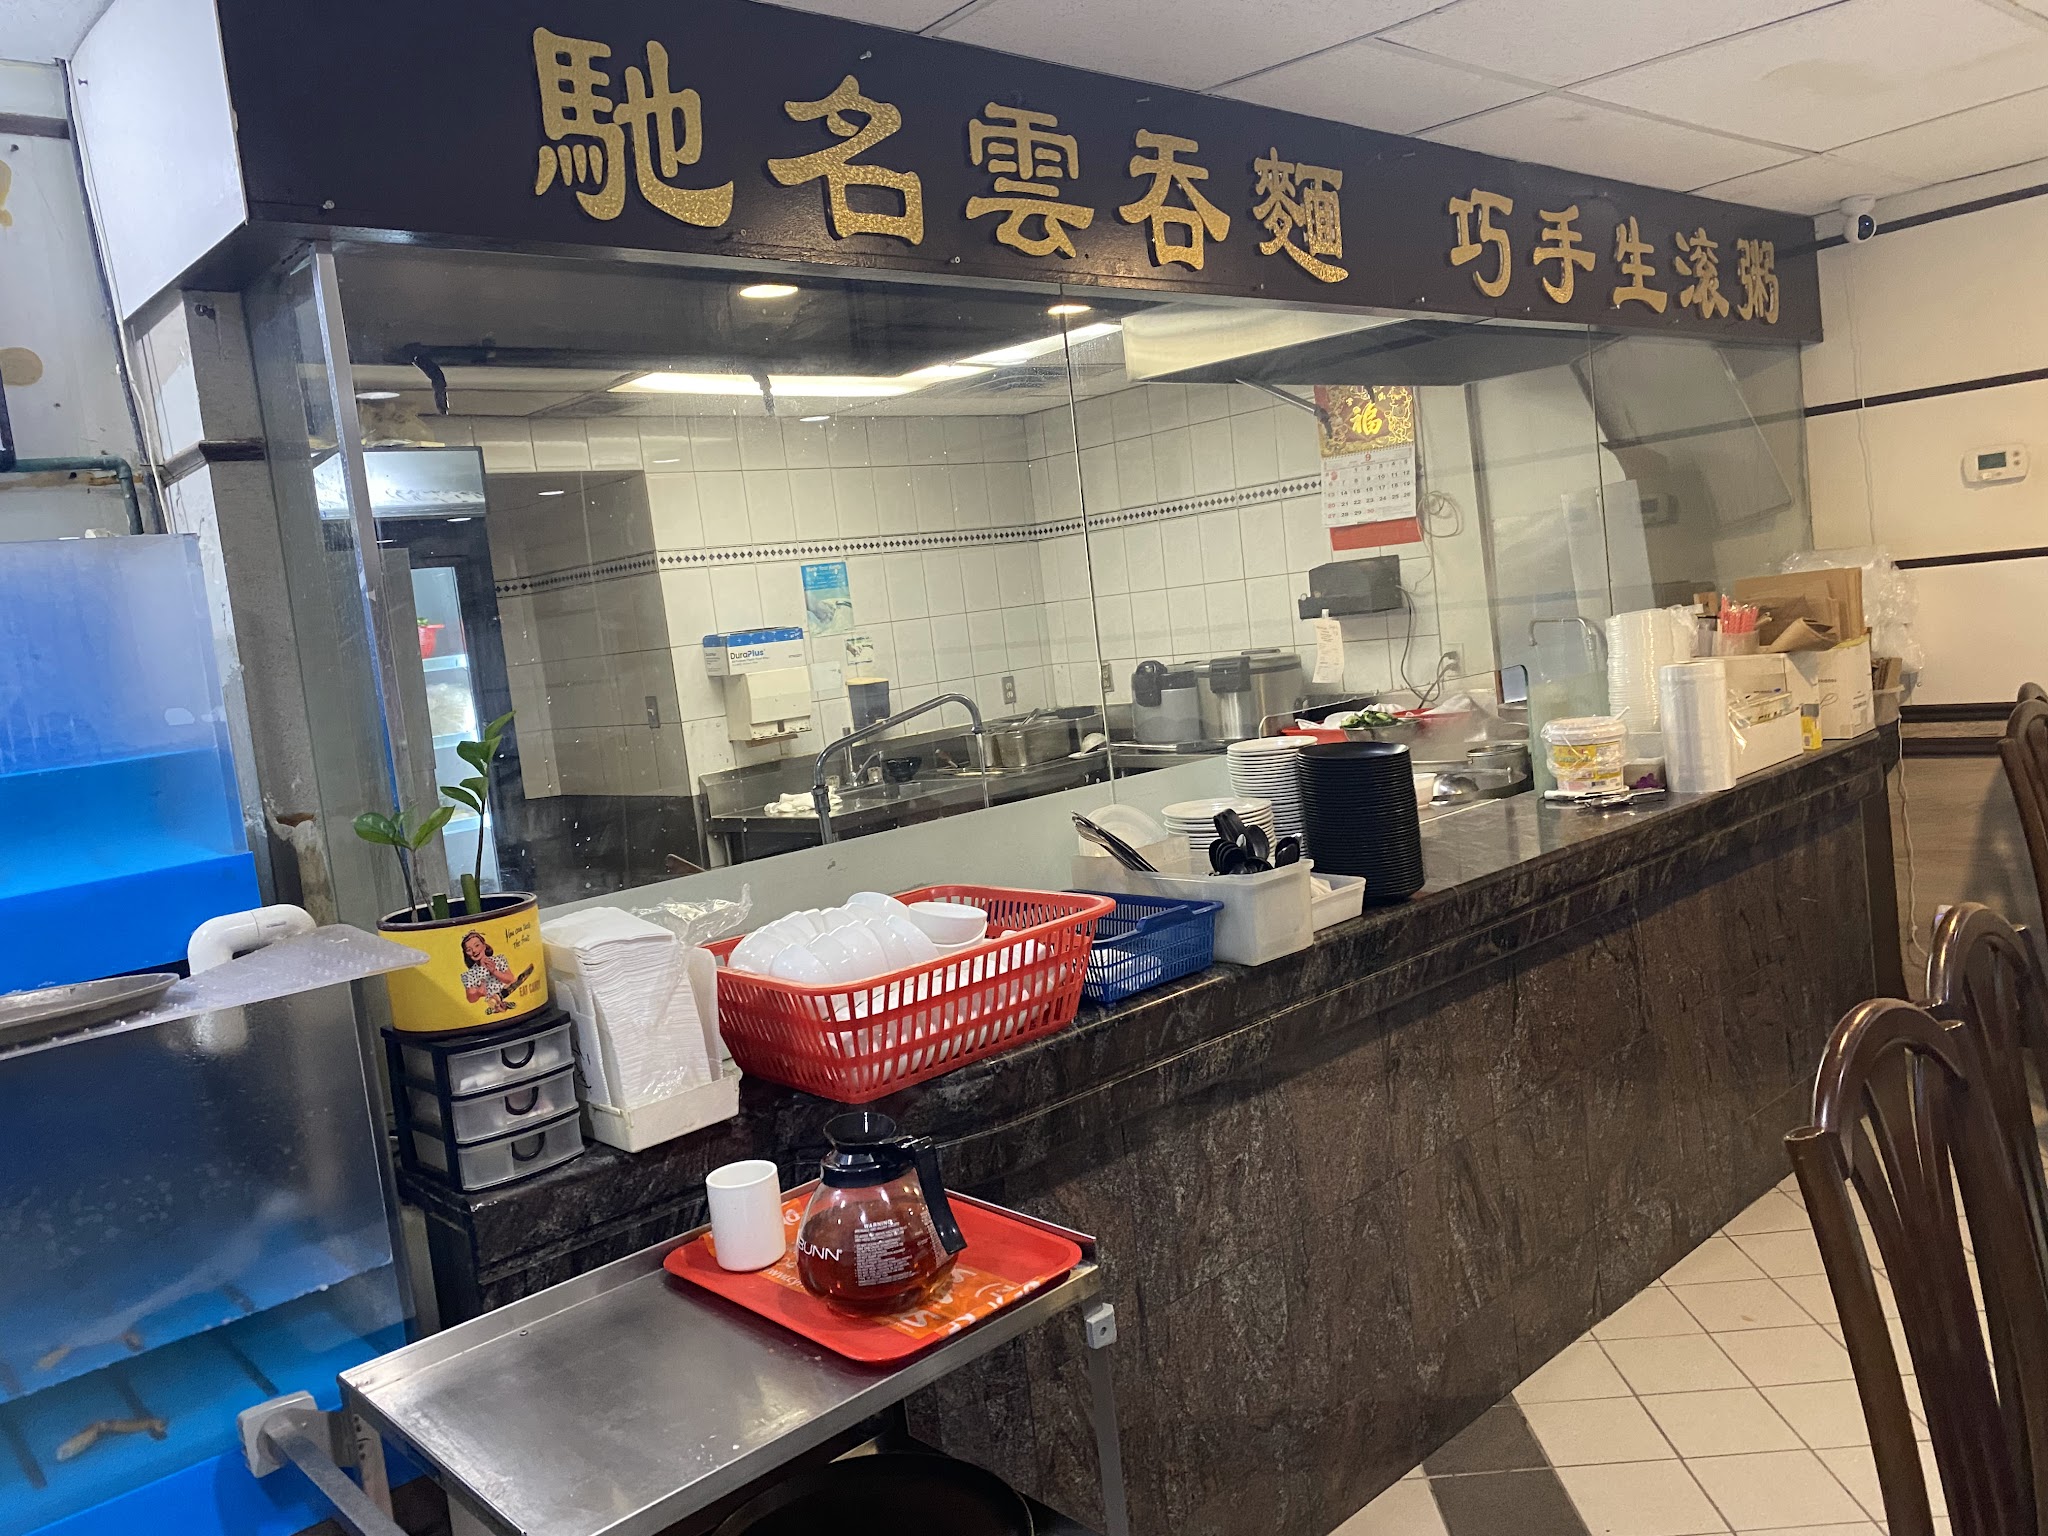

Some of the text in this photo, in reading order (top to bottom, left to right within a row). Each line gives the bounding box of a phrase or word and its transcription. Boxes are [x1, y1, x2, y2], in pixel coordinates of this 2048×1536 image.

[533, 27, 1349, 284] 馳名雲吞麵
[730, 649, 764, 660] DuraPlus
